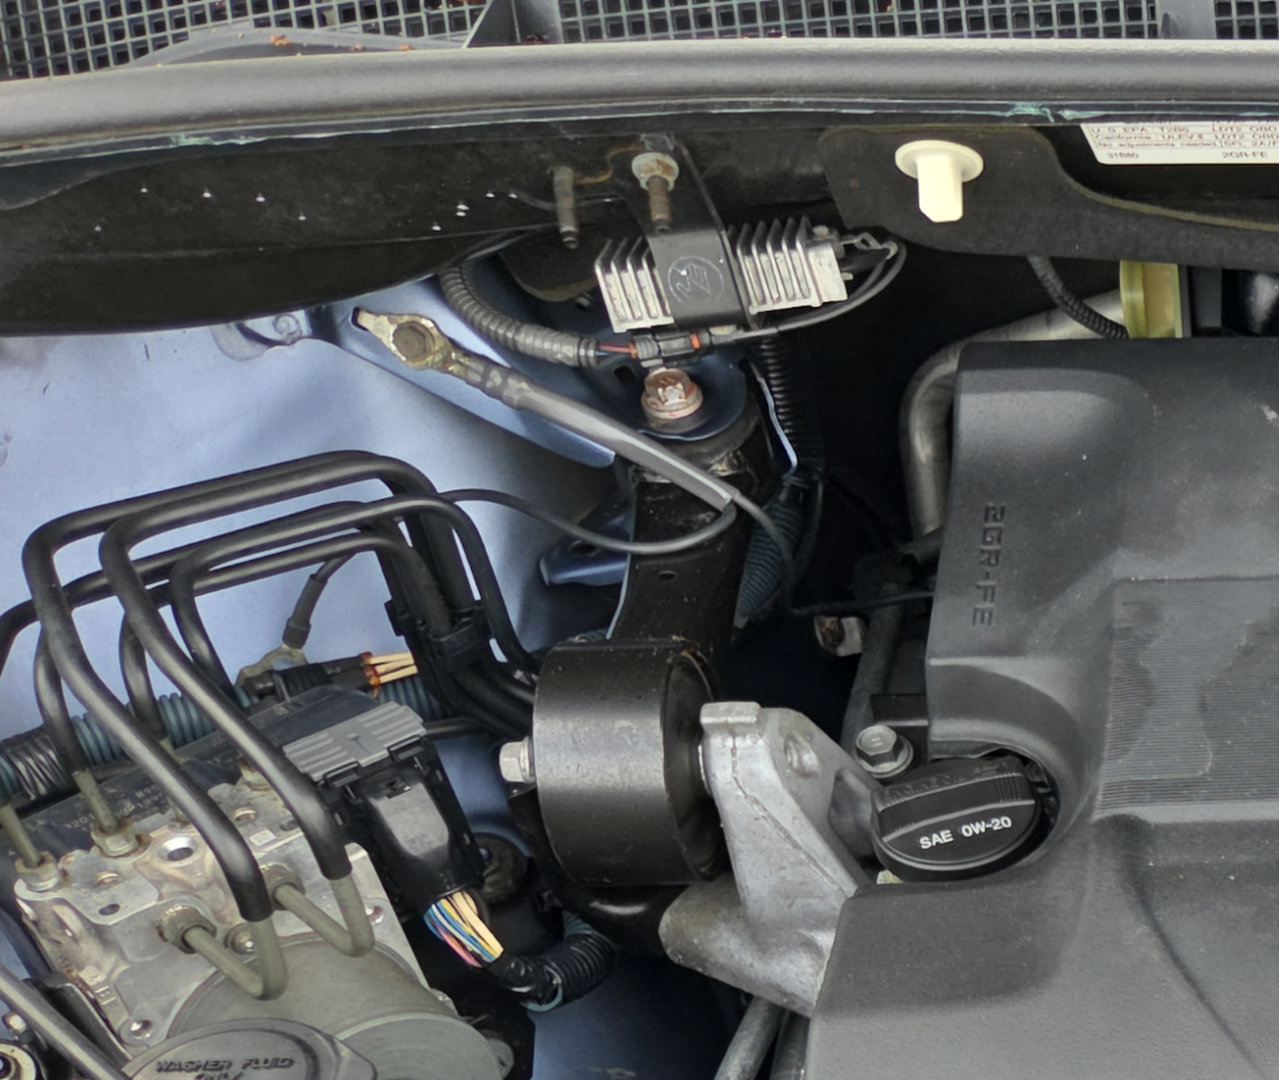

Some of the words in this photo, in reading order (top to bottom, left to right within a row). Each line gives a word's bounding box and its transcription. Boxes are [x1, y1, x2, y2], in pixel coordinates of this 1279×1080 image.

[968, 501, 1007, 628] 2GR-FE
[919, 829, 954, 849] SAE
[960, 816, 1012, 838] 0W-20
[156, 1058, 232, 1073] WASHER
[242, 1057, 295, 1070] FLUID
